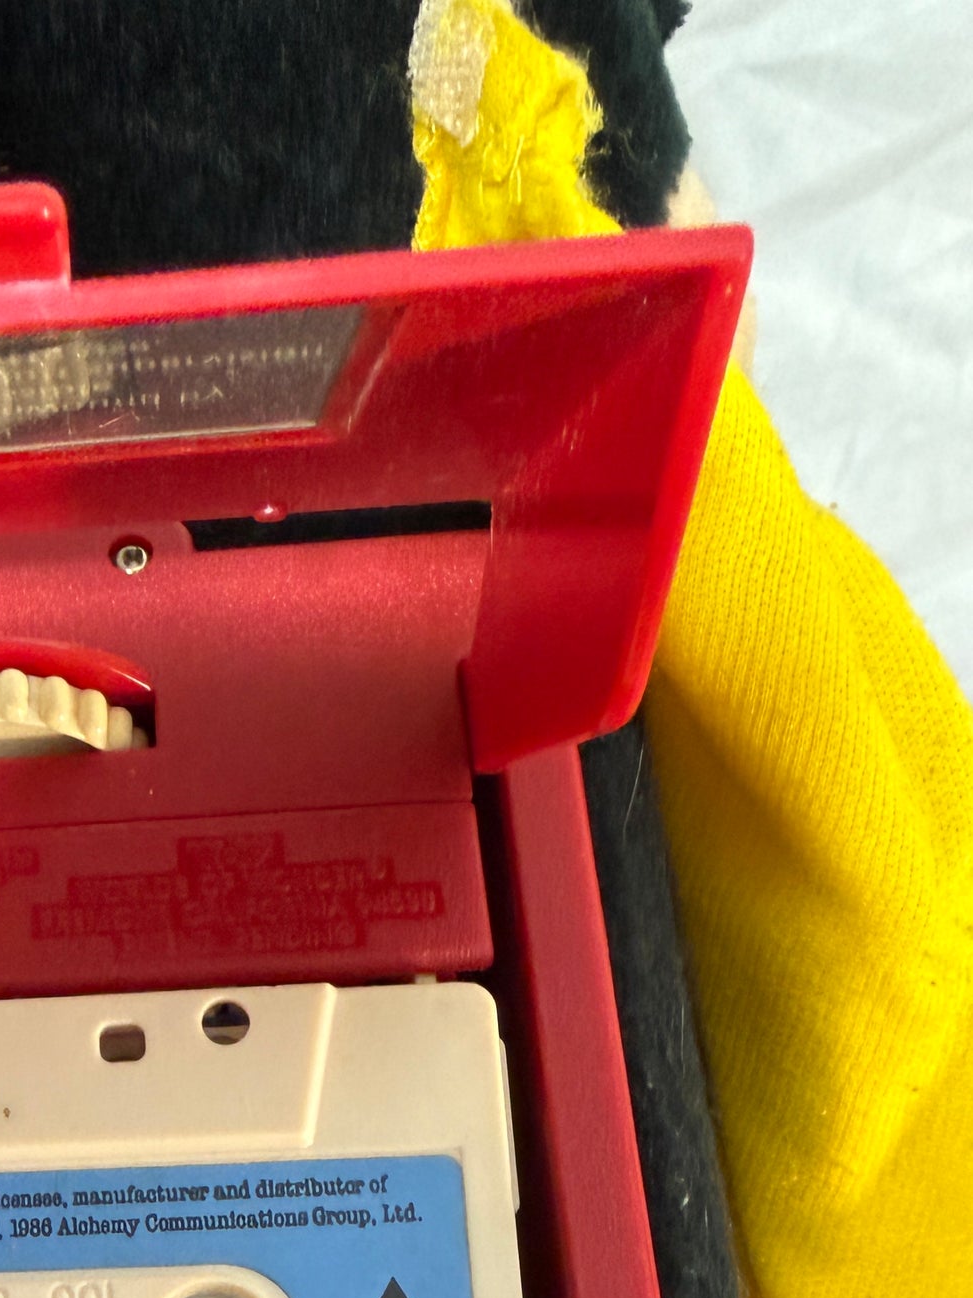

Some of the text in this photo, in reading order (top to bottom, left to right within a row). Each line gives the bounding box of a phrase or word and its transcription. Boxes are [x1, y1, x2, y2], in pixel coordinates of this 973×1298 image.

[73, 1185, 209, 1206] manufacturer
[213, 1180, 250, 1201] and
[255, 1177, 365, 1199] distributor
[369, 1174, 388, 1193] of
[10, 1217, 52, 1238] 1986
[57, 1216, 140, 1238] Alchemy
[145, 1209, 308, 1233] Communications
[312, 1206, 376, 1228] Group,
[382, 1202, 422, 1223] Ltd.
